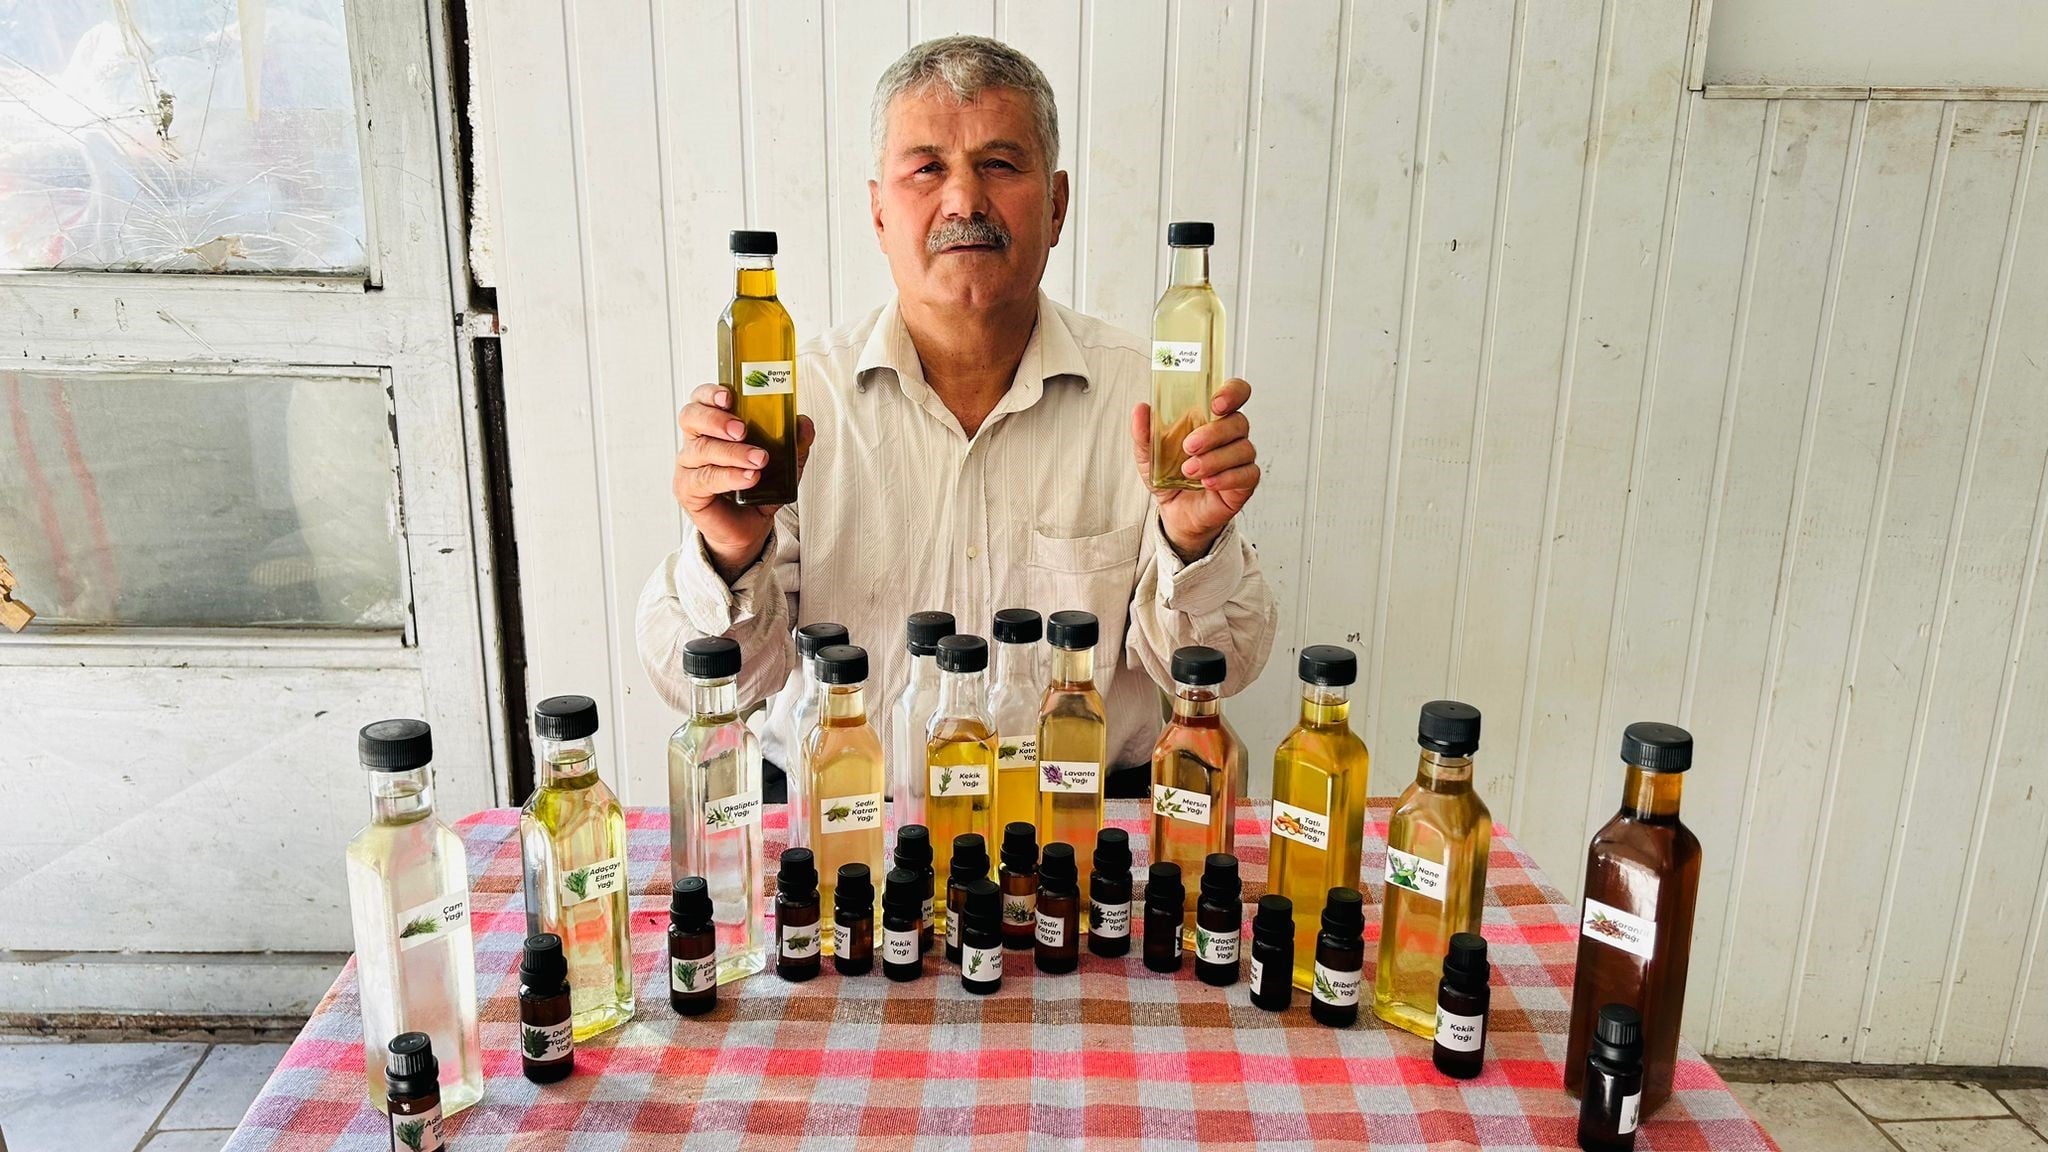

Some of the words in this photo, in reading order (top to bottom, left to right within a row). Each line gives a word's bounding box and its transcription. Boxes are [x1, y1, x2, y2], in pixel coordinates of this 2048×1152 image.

[772, 376, 787, 384] Yağı
[1071, 777, 1088, 785] Yağı
[723, 799, 759, 813] Okaliptus
[855, 799, 875, 807] Sedir
[1182, 798, 1207, 808] Mersin
[733, 809, 750, 818] Yağı
[851, 807, 878, 815] Katran
[1187, 806, 1203, 815] Yağı
[1304, 816, 1321, 827] Tatlı
[1298, 823, 1326, 836] Badem
[1303, 832, 1320, 843] Yağı
[589, 861, 621, 876] Adaçayı
[1418, 867, 1440, 878] Nane
[595, 871, 615, 882] Elma
[1420, 876, 1437, 887] Yağı
[597, 880, 614, 889] Yağı
[442, 902, 463, 915] Çam
[444, 911, 463, 922] Yağı
[1040, 918, 1058, 928] Sedir
[1037, 924, 1061, 935] Katran
[1041, 933, 1056, 943] Yağı
[1620, 931, 1640, 943] Yağı
[892, 948, 910, 956] Yağı
[1450, 1023, 1475, 1032] Kekik
[1452, 1033, 1472, 1042] Yağı
